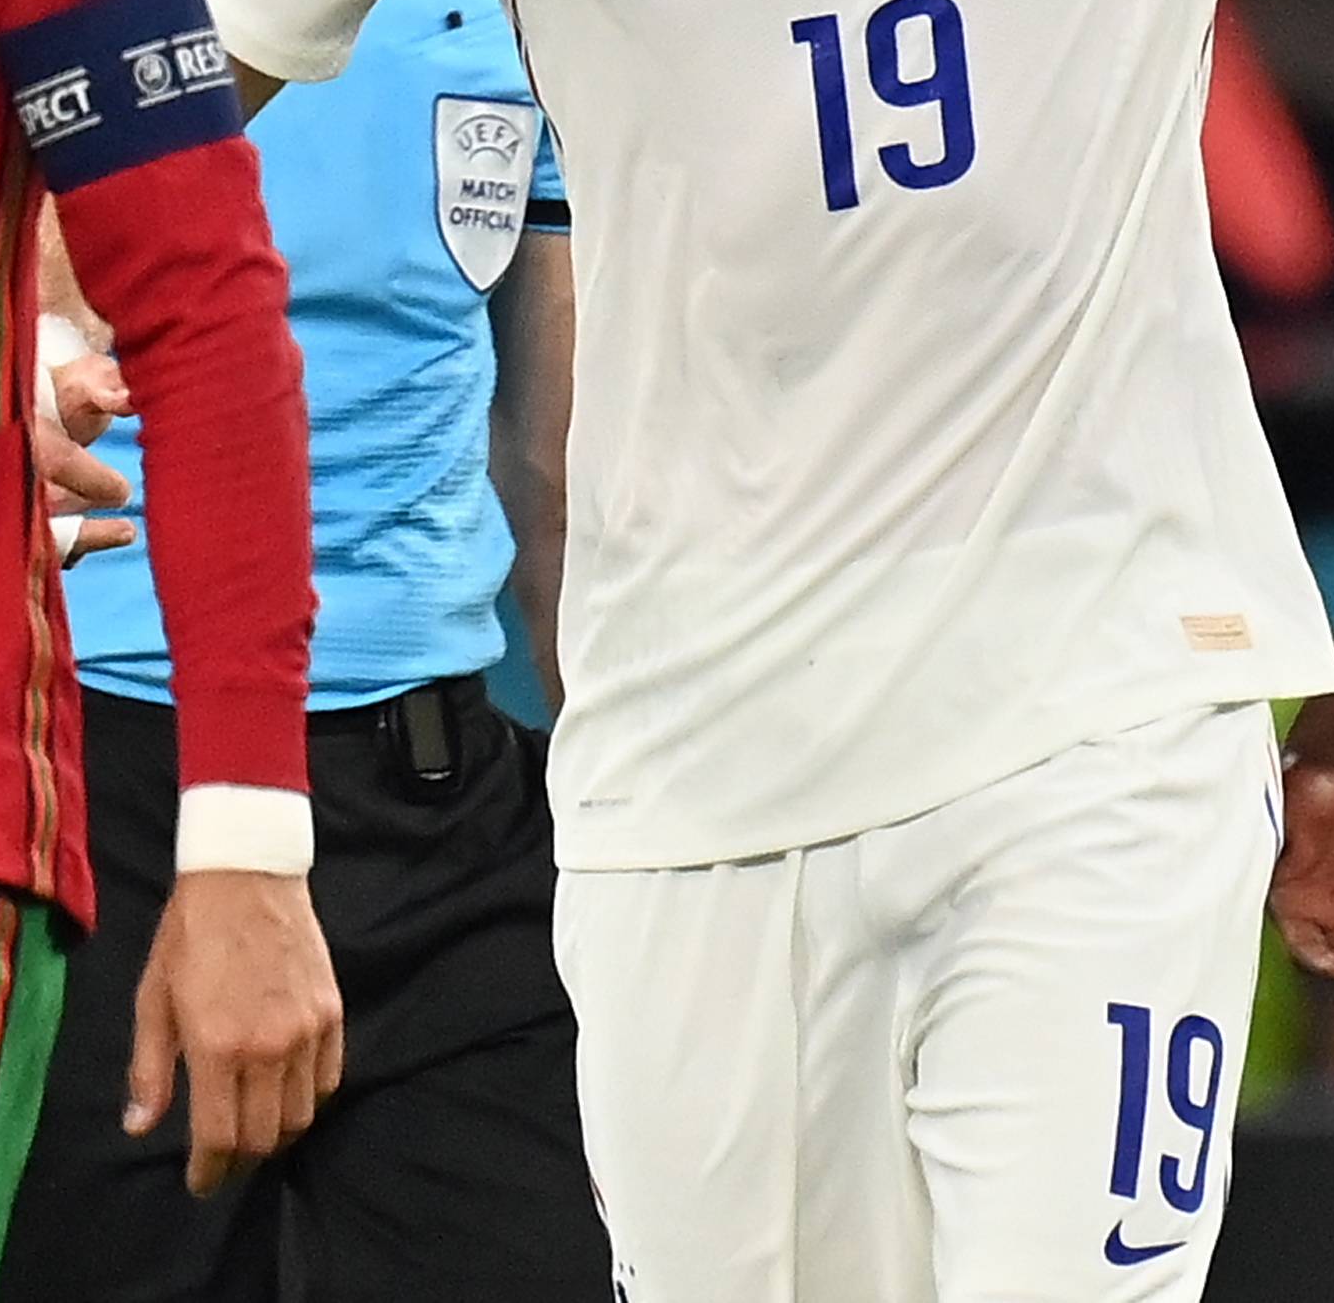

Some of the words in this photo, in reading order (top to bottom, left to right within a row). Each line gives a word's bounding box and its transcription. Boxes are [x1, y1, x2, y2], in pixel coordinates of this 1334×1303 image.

[457, 122, 523, 156] UEFA
[460, 179, 517, 201] MATCH
[1107, 1001, 1224, 1214] 19
